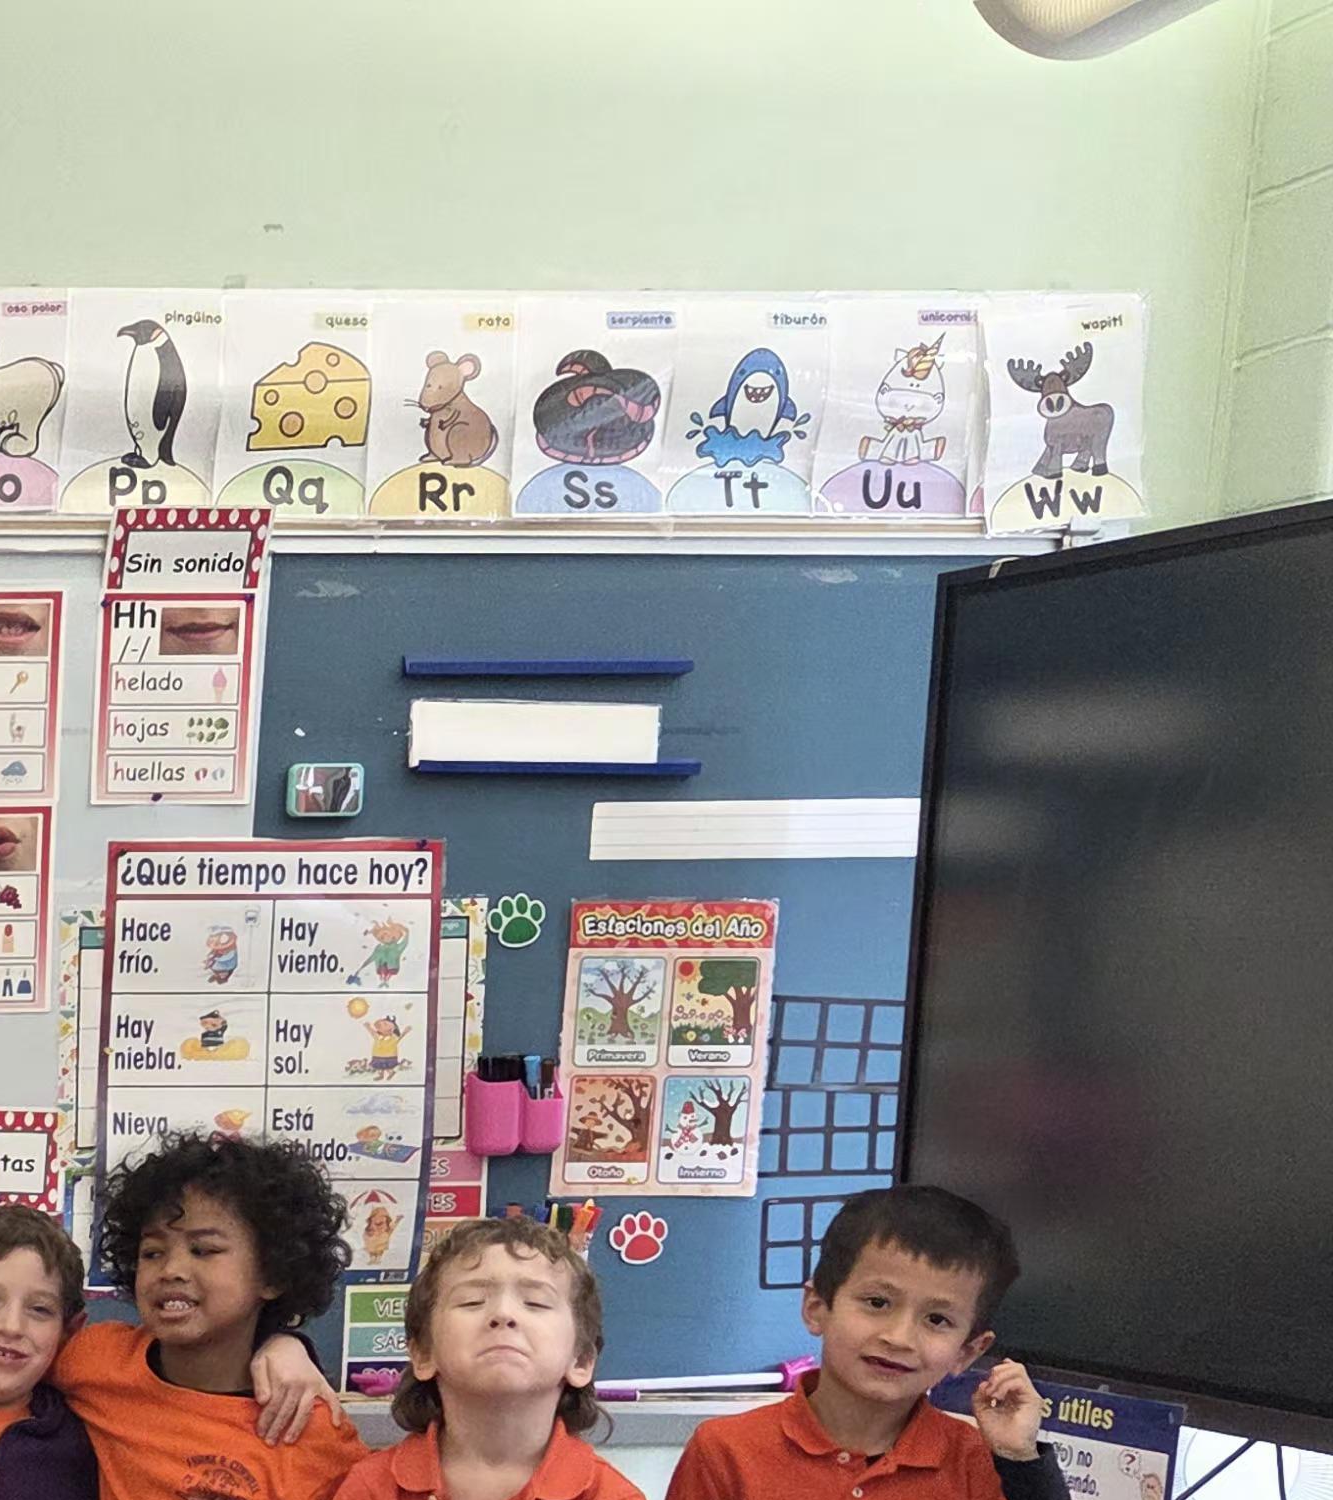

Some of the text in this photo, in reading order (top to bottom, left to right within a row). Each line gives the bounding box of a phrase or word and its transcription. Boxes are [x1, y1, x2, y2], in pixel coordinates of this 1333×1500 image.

[419, 473, 475, 512] Rr
[563, 471, 618, 509] Ss
[863, 470, 920, 511] Uu
[126, 554, 244, 573] Sin sonido
[113, 762, 185, 782] huellas
[121, 857, 427, 892] ¿Qué tiempo hace hoy?
[122, 918, 171, 941] Hace
[280, 918, 318, 945] Hay
[583, 915, 762, 938] Estaciones del Año
[118, 950, 158, 974] frío.
[278, 950, 344, 974] viento.
[116, 1016, 153, 1043] Hay
[276, 1020, 312, 1047] Hay
[115, 1047, 182, 1071] niebla.
[274, 1052, 309, 1074] sol.
[688, 1050, 730, 1062] Verano
[272, 1107, 313, 1131] Está
[678, 1167, 726, 1179] Invierno
[1058, 1395, 1114, 1430] útiles
